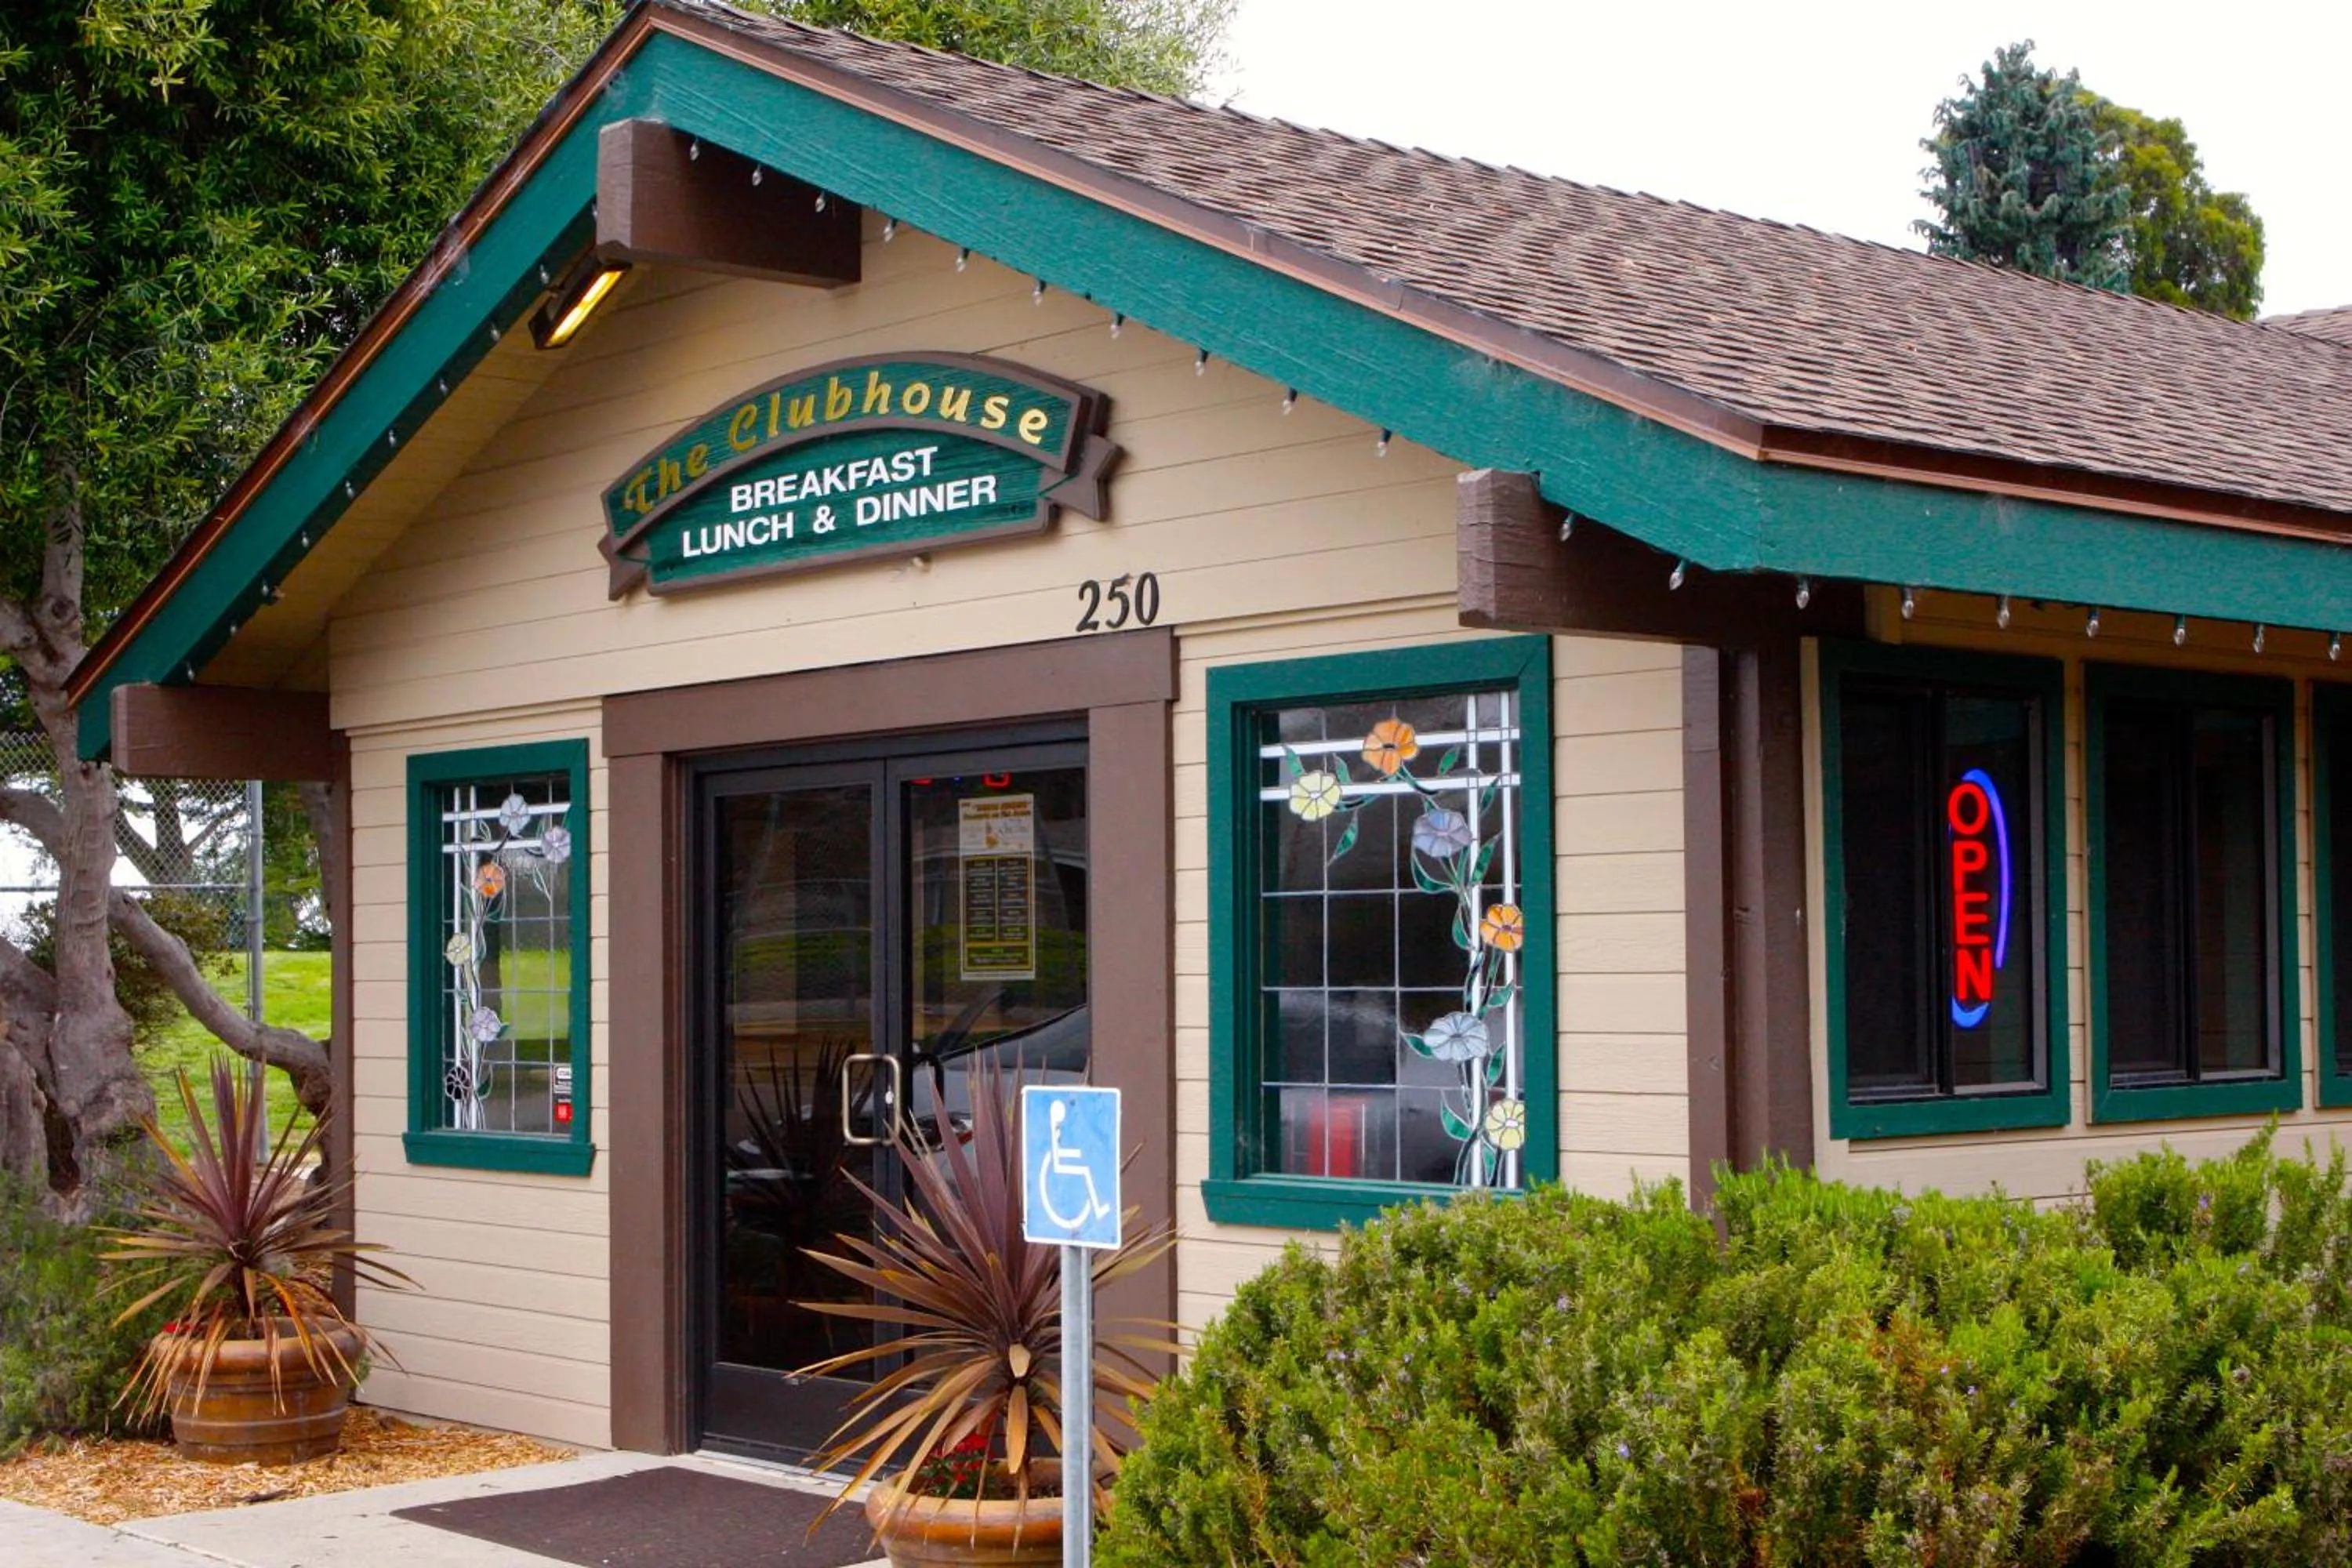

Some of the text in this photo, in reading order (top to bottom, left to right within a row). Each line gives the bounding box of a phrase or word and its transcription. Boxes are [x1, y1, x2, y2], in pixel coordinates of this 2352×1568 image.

[624, 371, 1048, 514] The Clubhouse
[731, 446, 938, 512] BREAKFAST
[682, 474, 997, 558] LUNCH & DINNER
[1076, 572, 1160, 633] 250
[1947, 782, 1994, 1001] OPEN
